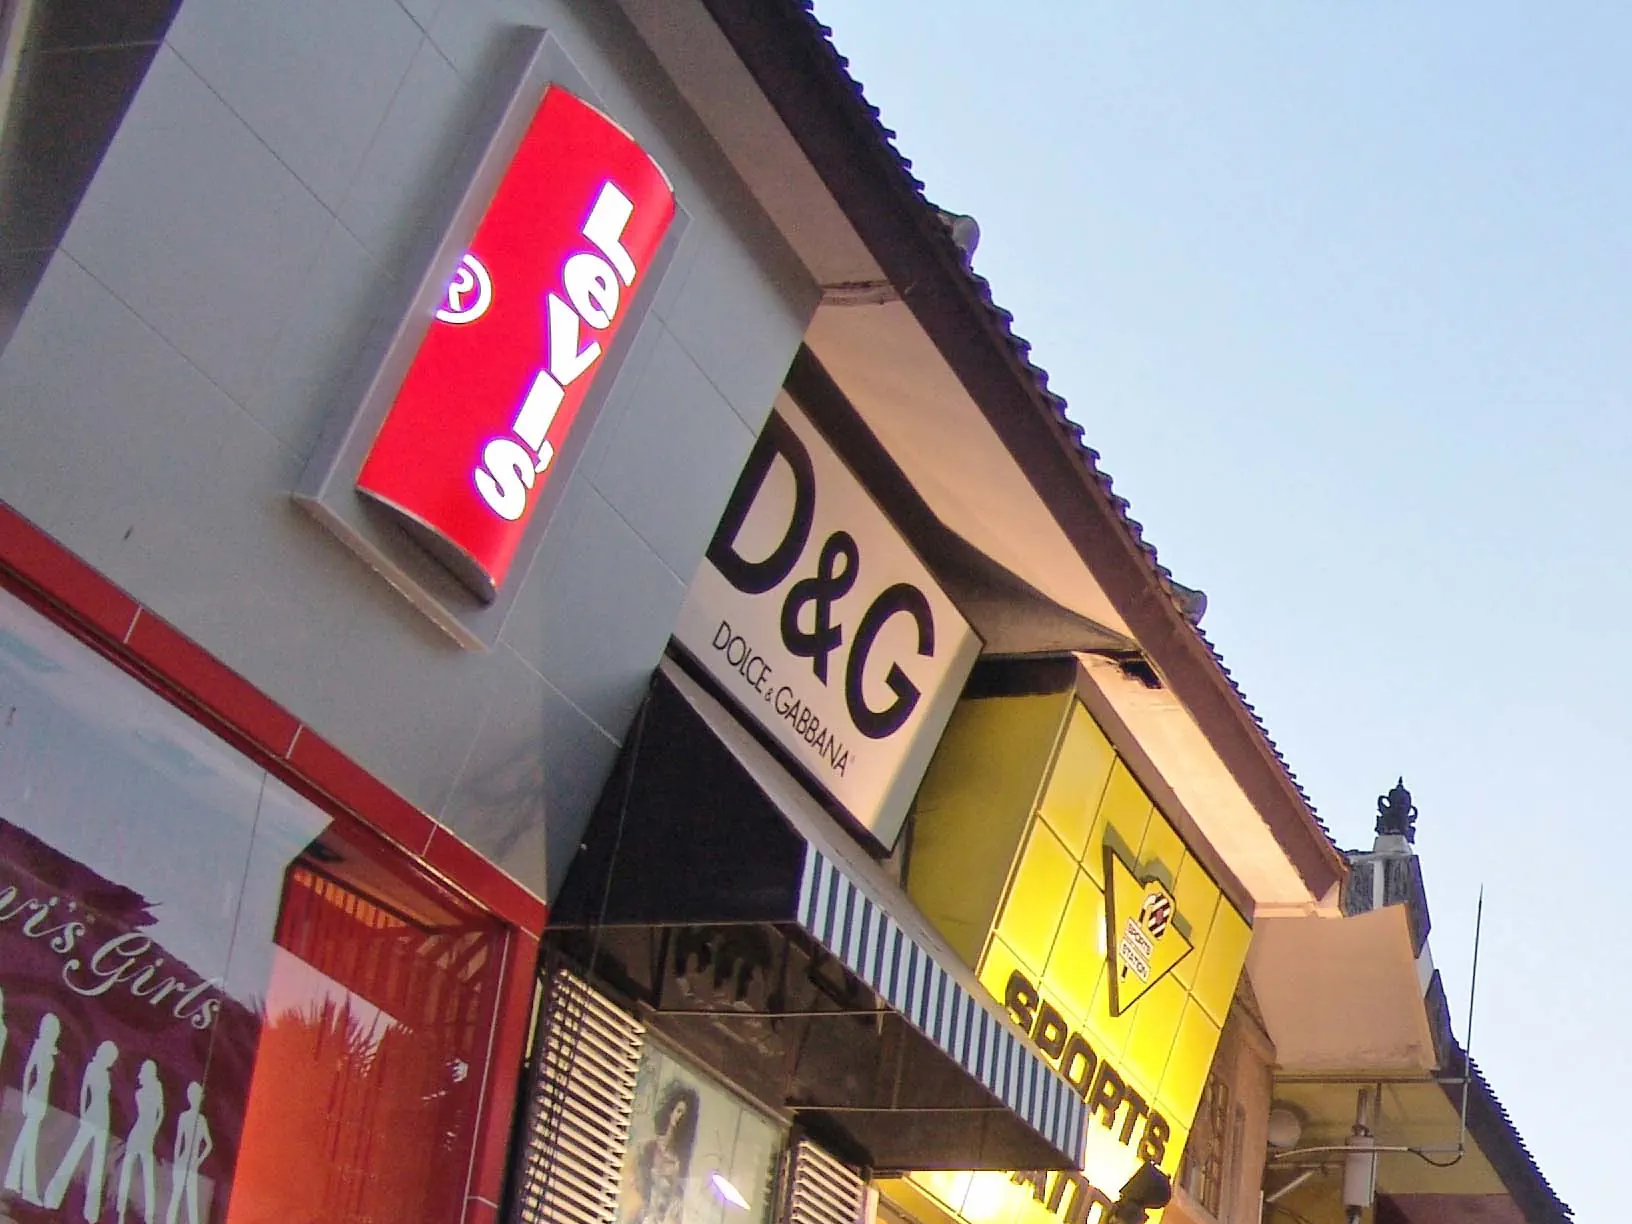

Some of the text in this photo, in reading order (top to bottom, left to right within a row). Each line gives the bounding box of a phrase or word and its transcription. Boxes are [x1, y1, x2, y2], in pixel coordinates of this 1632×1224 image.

[705, 408, 935, 739] D&G
[711, 621, 772, 696] DOLCE
[773, 685, 850, 778] GABBANA
[62, 930, 221, 1030] Girls
[1120, 942, 1149, 980] STATION
[1126, 922, 1151, 958] SPORTS
